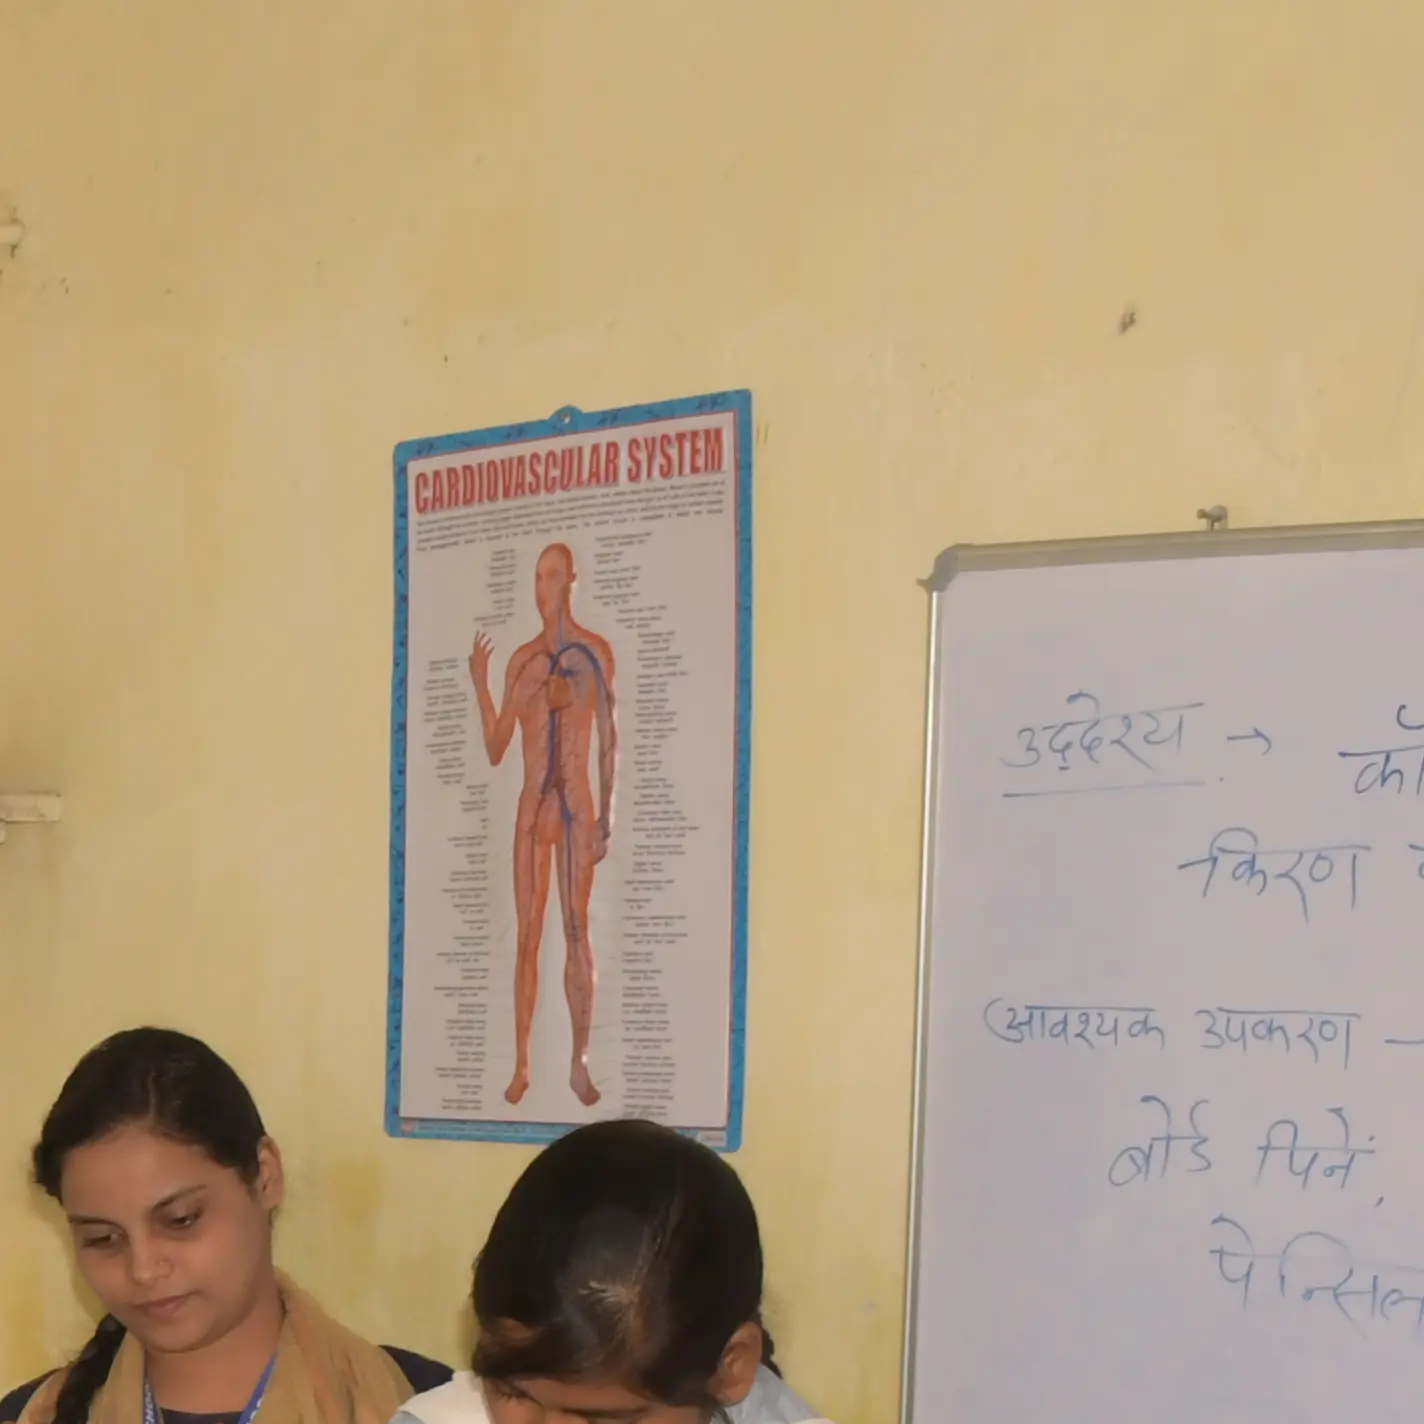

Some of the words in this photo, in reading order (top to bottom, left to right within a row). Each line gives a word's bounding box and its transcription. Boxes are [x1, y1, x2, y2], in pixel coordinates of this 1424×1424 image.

[415, 441, 620, 515] CARDIOVASCULAR
[627, 427, 723, 483] SYSTEM
[1177, 826, 1372, 923] किरण
[984, 996, 1166, 1050] आवश्यक
[1195, 1006, 1362, 1070] उपकरण
[1108, 1095, 1212, 1187] बोर्ड
